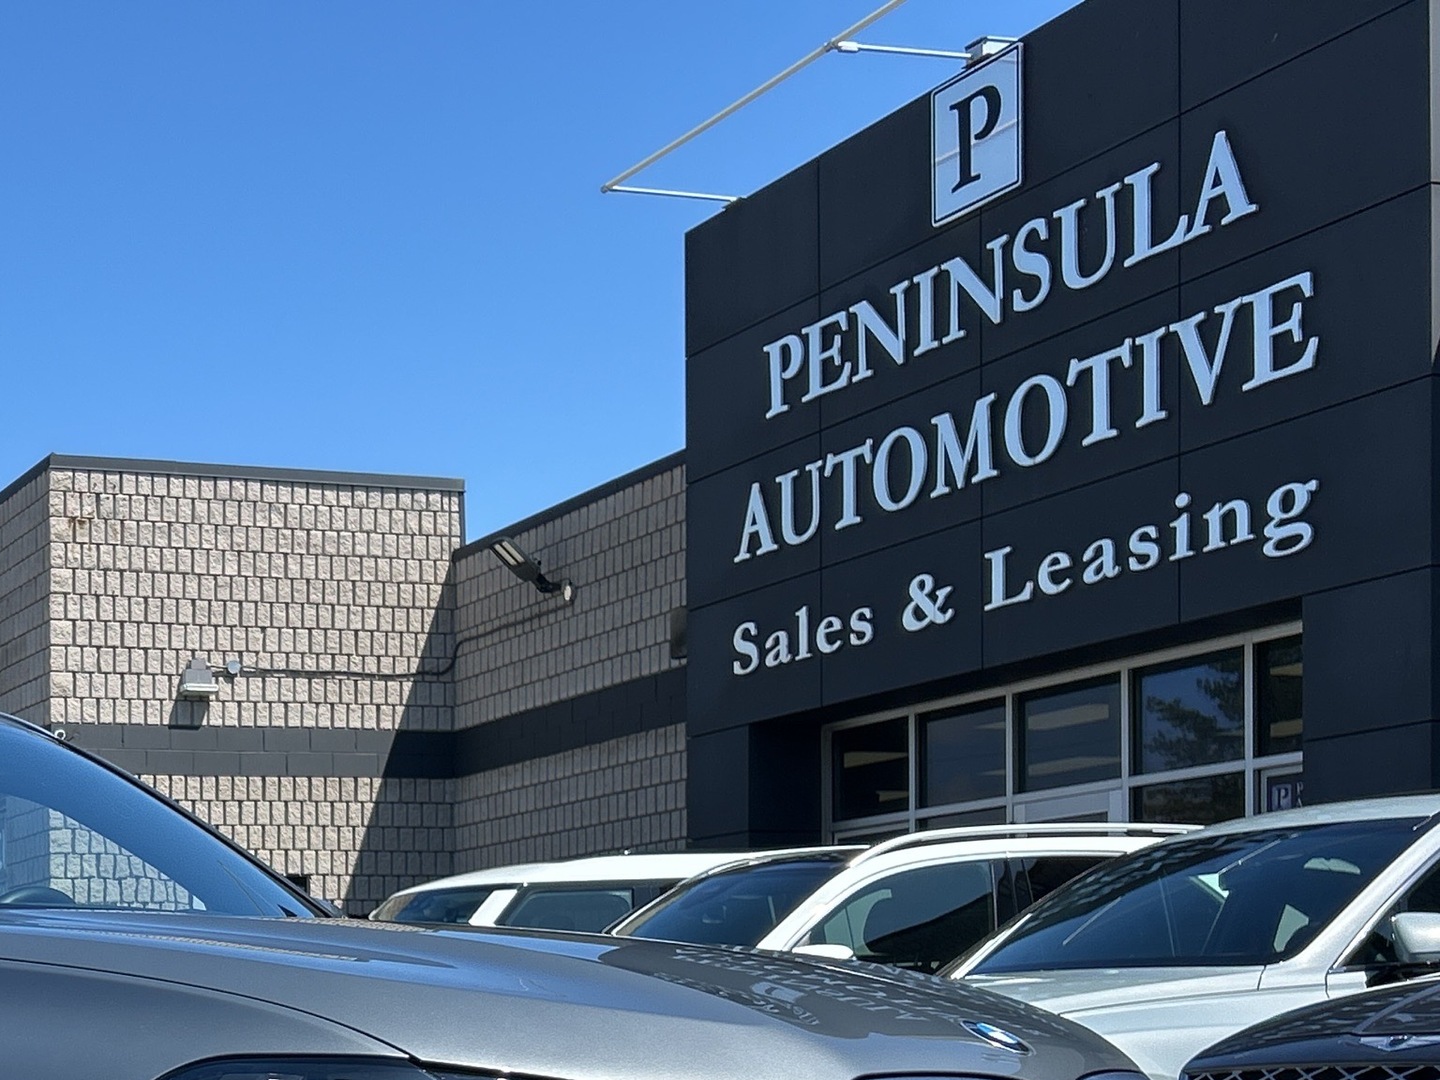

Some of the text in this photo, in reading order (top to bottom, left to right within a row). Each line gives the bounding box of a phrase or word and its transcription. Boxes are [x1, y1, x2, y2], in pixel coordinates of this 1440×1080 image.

[948, 84, 1002, 196] P
[762, 129, 1260, 421] PENINSULA
[732, 271, 1321, 564] AUTOMOTIVE
[732, 478, 1320, 676] Sales & Leasing
